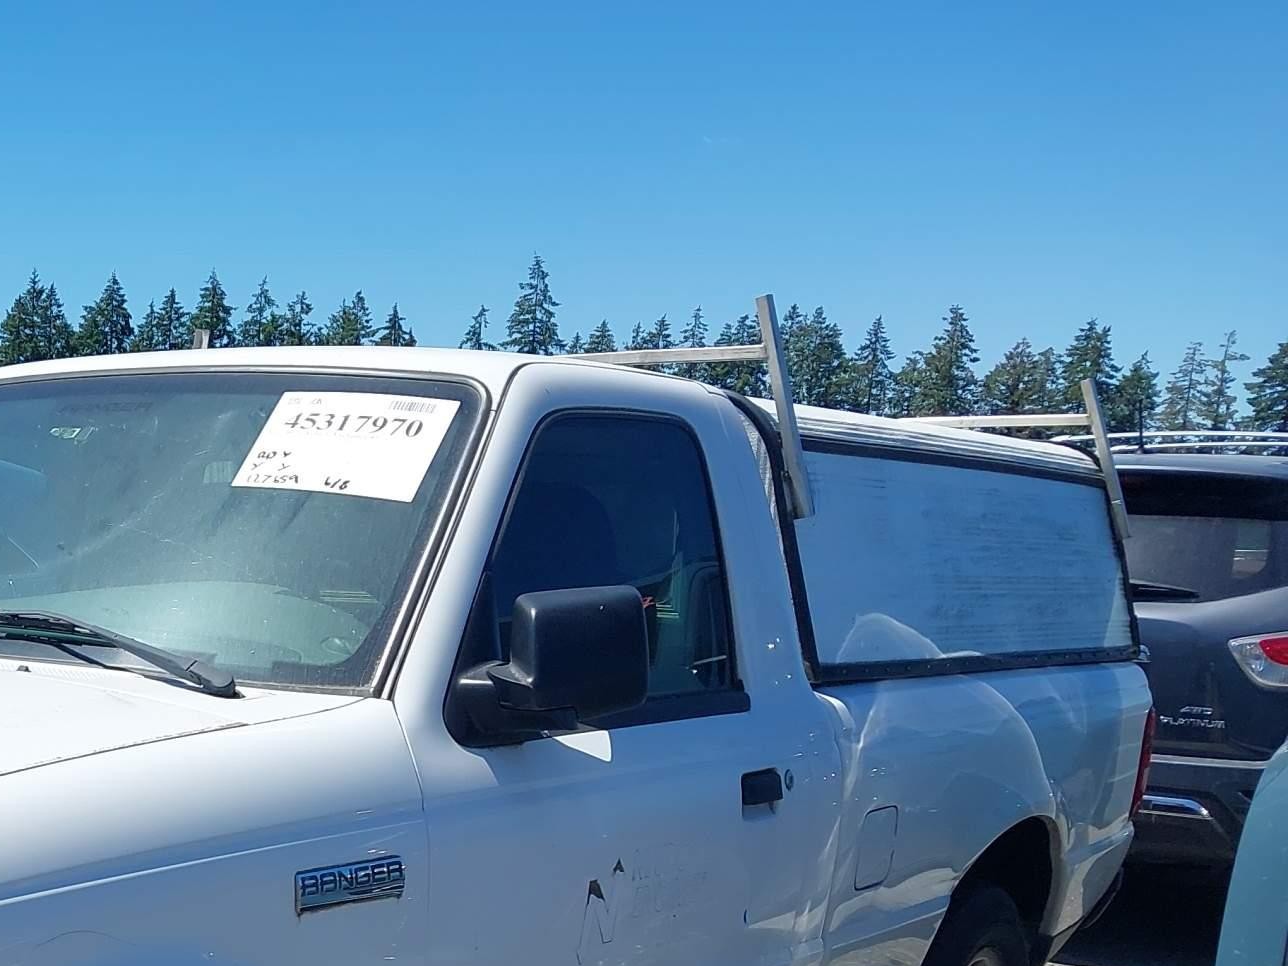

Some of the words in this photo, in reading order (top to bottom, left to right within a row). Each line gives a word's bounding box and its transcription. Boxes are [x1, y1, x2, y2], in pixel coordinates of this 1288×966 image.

[284, 412, 424, 438] 45317970
[1159, 715, 1226, 729] PLATINUM
[300, 860, 405, 897] RANGER
